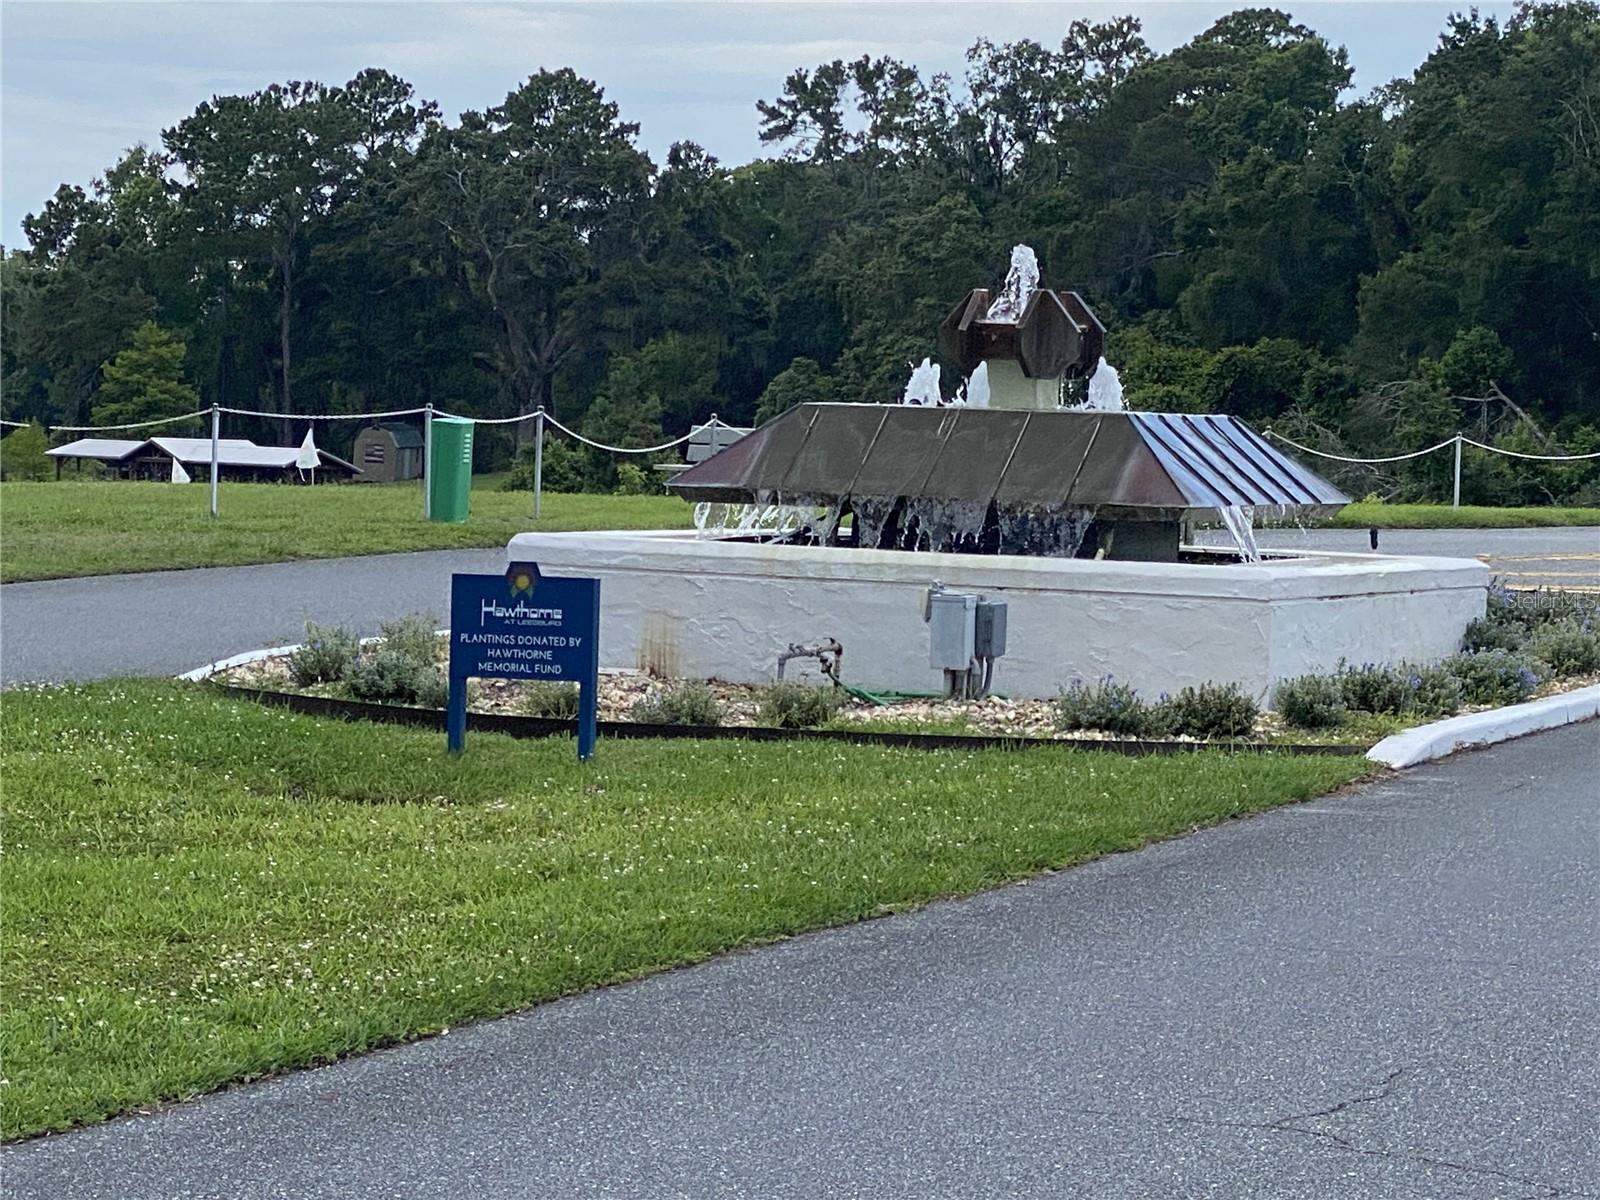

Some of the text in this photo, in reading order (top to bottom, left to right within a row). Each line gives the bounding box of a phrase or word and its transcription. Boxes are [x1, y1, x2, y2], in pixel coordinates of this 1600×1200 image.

[481, 598, 562, 627] Hawthorne
[460, 633, 581, 647] PLANTINGS DONATED BY
[487, 649, 553, 660] HAWTHORNE
[478, 662, 562, 674] MEMORIAL FUND
